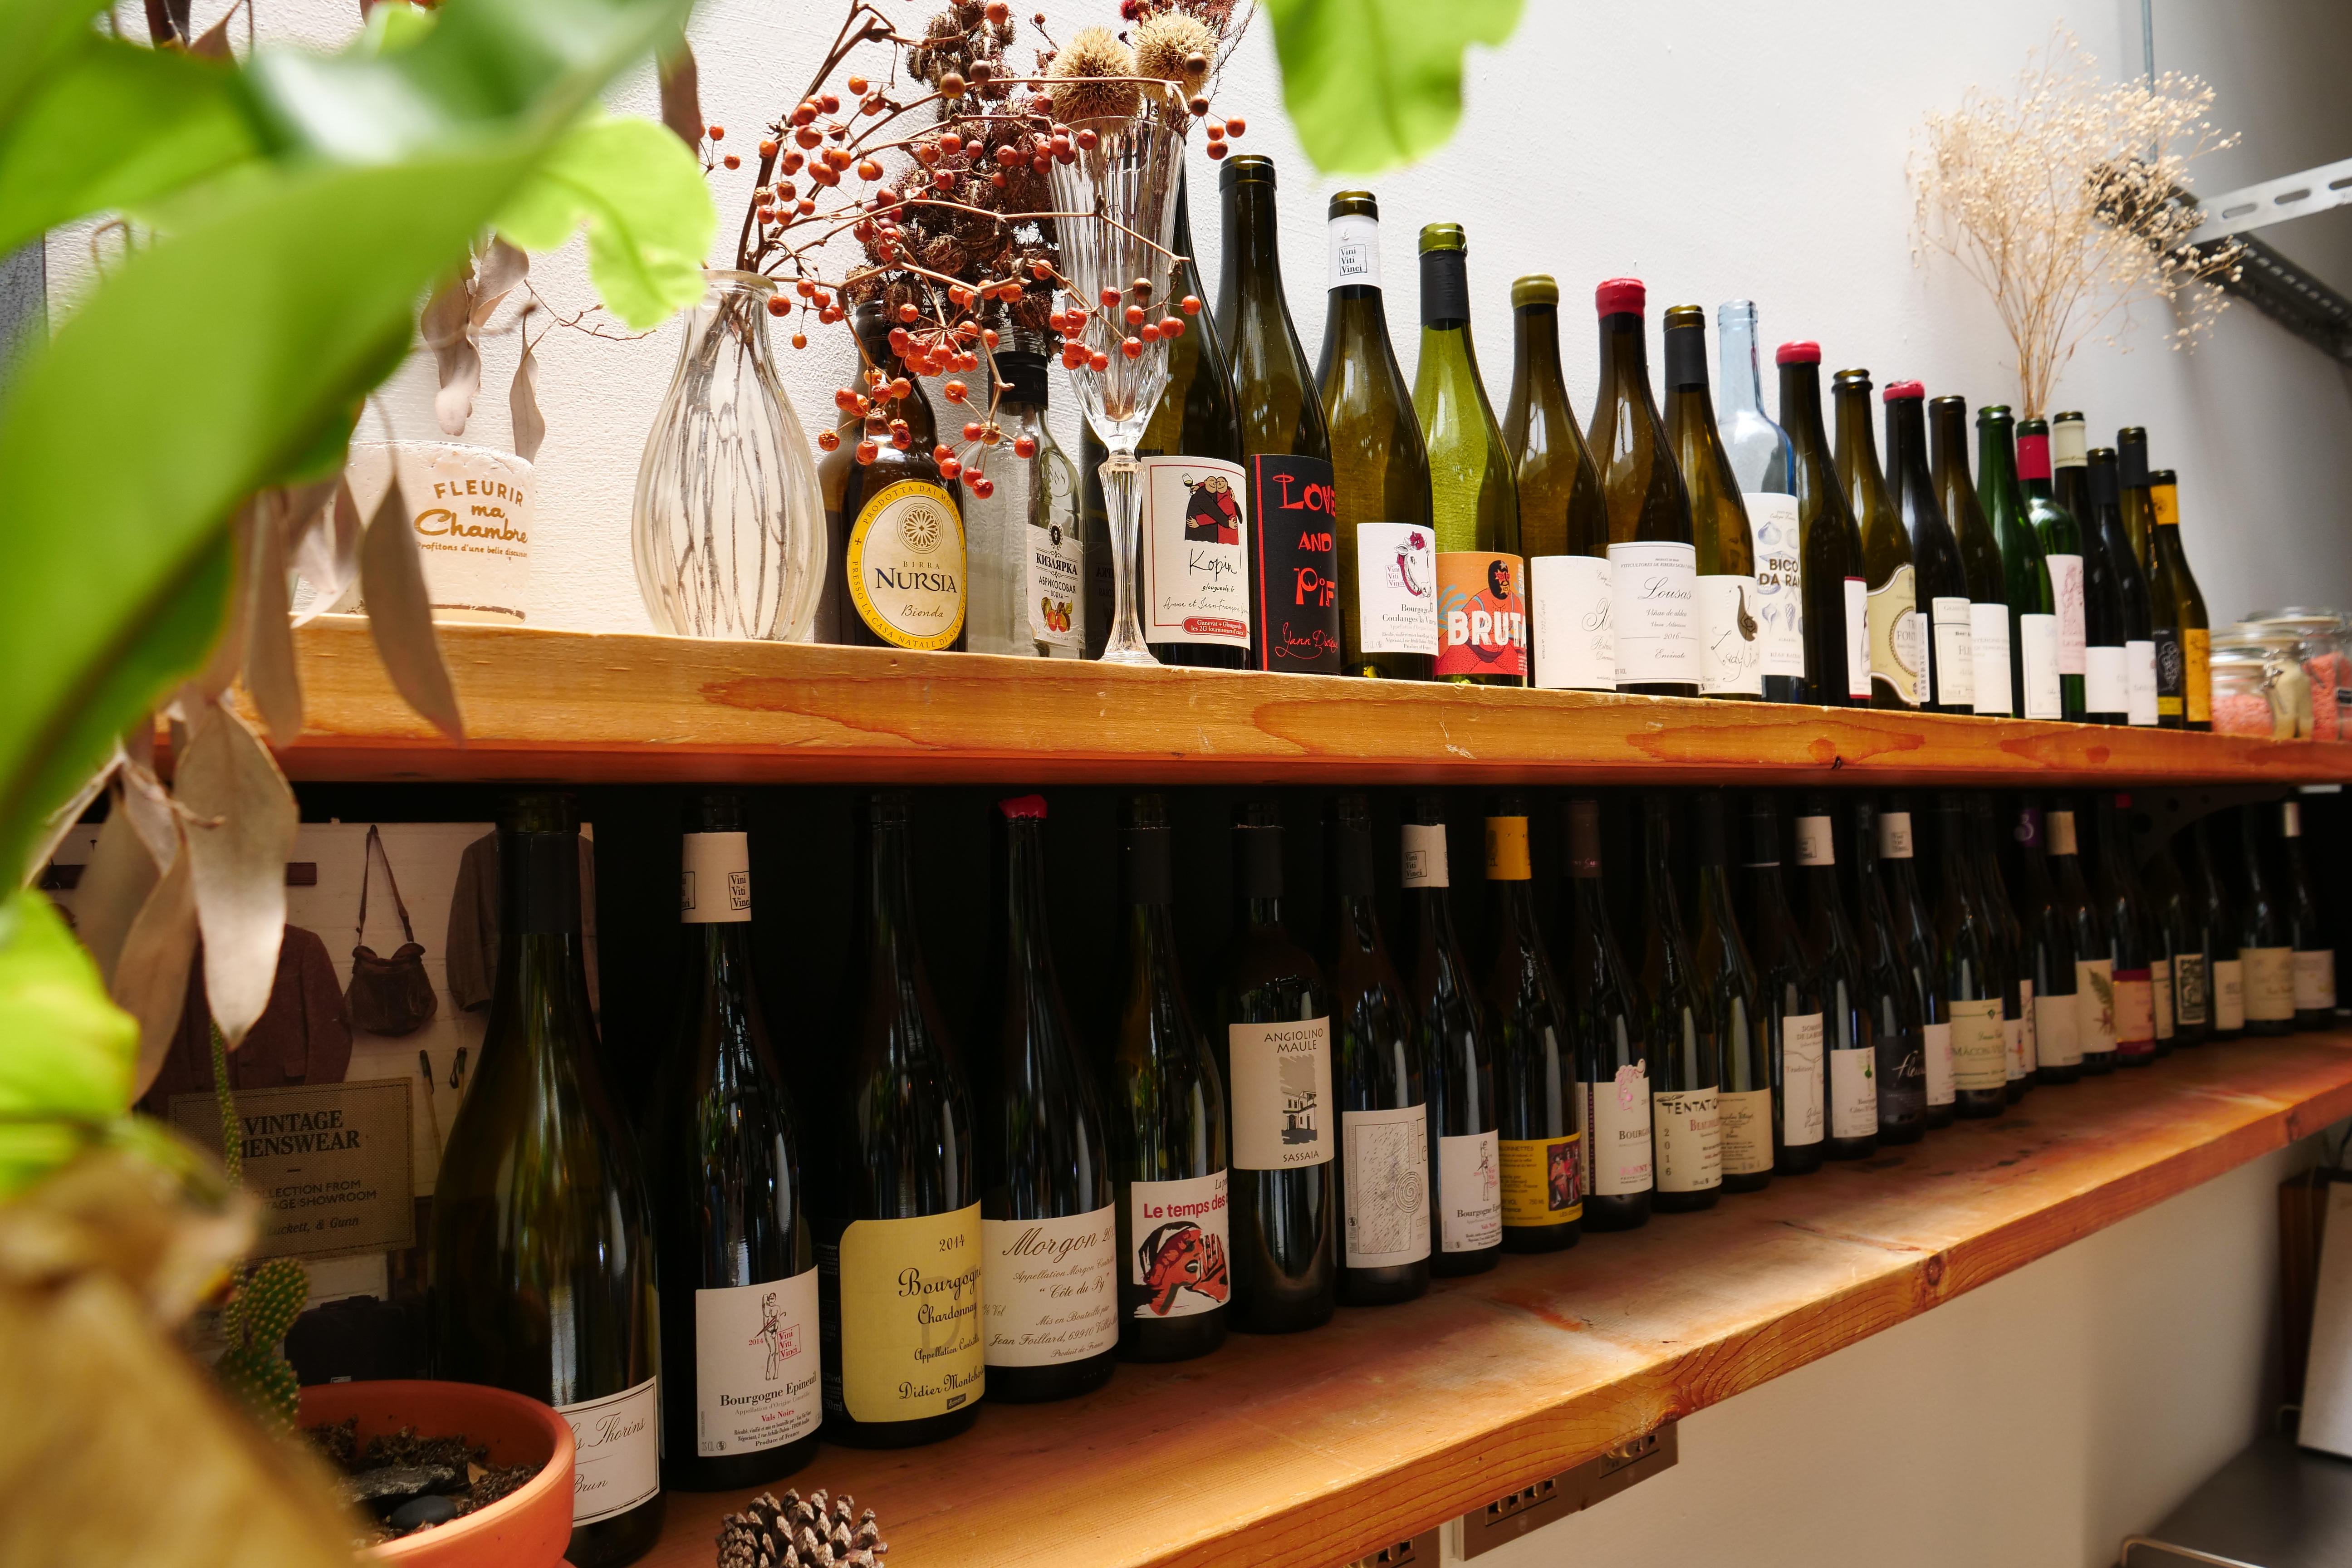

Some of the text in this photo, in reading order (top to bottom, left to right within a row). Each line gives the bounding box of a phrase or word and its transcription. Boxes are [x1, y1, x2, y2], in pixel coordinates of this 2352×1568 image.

[1341, 247, 1356, 255] Vini
[1341, 256, 1355, 265] Viti
[1341, 264, 1362, 273] Vinci
[434, 480, 523, 507] FLEURIR
[471, 505, 505, 518] ma
[863, 485, 962, 530] PRODOTTA DAI MONACI
[413, 508, 528, 544] Chambre
[1298, 531, 1332, 552] AND
[461, 544, 484, 553] d'une
[487, 546, 503, 555] belle
[903, 561, 940, 569] BIRRA
[1036, 553, 1078, 575] КИЗЛЯРКА
[1769, 558, 1798, 571] BICO
[874, 568, 957, 593] NURSIA
[1039, 575, 1076, 594] АБРИКОСОВАЯ
[1759, 573, 1781, 586] DA
[1051, 590, 1064, 599] ВОДКА
[1637, 577, 1692, 600] Lousas
[852, 561, 864, 599] PRESSO
[862, 603, 871, 616] LA
[872, 617, 893, 637] CASA
[897, 635, 936, 648] NATALE
[939, 636, 949, 646] DI
[950, 623, 960, 639] SAN
[1163, 596, 1186, 610] Anne
[901, 604, 944, 617] Bionda
[1666, 608, 1674, 617] de
[1382, 614, 1424, 625] Coulanges la
[730, 874, 746, 885] Vini
[731, 886, 746, 896] Viti
[732, 897, 750, 908] Vinci
[1264, 1028, 1323, 1042] ANGIOLINO
[1277, 1039, 1317, 1054] MAULE
[243, 1109, 343, 1135] VINTAGE
[1283, 1150, 1319, 1162] SASSAIA
[251, 1180, 361, 1200] OLLECTION FROM
[299, 1189, 377, 1207] SHOWROOM
[1144, 1194, 1225, 1218] Le temps des
[1457, 1208, 1492, 1219] Bourgogne
[330, 1216, 359, 1229] Gunn
[939, 1233, 965, 1253] 2014
[1002, 1226, 1097, 1264] Morgon
[1013, 1264, 1094, 1284] Appellation Morgon
[1076, 1281, 1089, 1295] du
[917, 1301, 978, 1325] Chardonnay
[993, 1304, 1006, 1317] Vol
[1036, 1315, 1053, 1326] Mis
[1066, 1305, 1100, 1323] Bouteille
[778, 1328, 794, 1340] Vini
[989, 1326, 1094, 1347] Jean Foillard, 69910
[748, 1338, 764, 1346] 2014
[779, 1339, 792, 1348] Viti
[780, 1347, 798, 1358] Vinci
[914, 1345, 959, 1364] Appellation
[1050, 1348, 1078, 1357] Produit
[1078, 1345, 1085, 1353] de
[720, 1387, 784, 1407] Bourgogne
[786, 1371, 817, 1396] Epineuil
[898, 1381, 943, 1400] Didier
[735, 1406, 768, 1416] Appellation
[769, 1400, 792, 1409] d'Origine
[761, 1409, 795, 1422] Vals Noirs
[588, 1411, 646, 1447] Thorins
[755, 1436, 778, 1447] Produce
[785, 1431, 800, 1440] France
[574, 1474, 608, 1494] Brun
